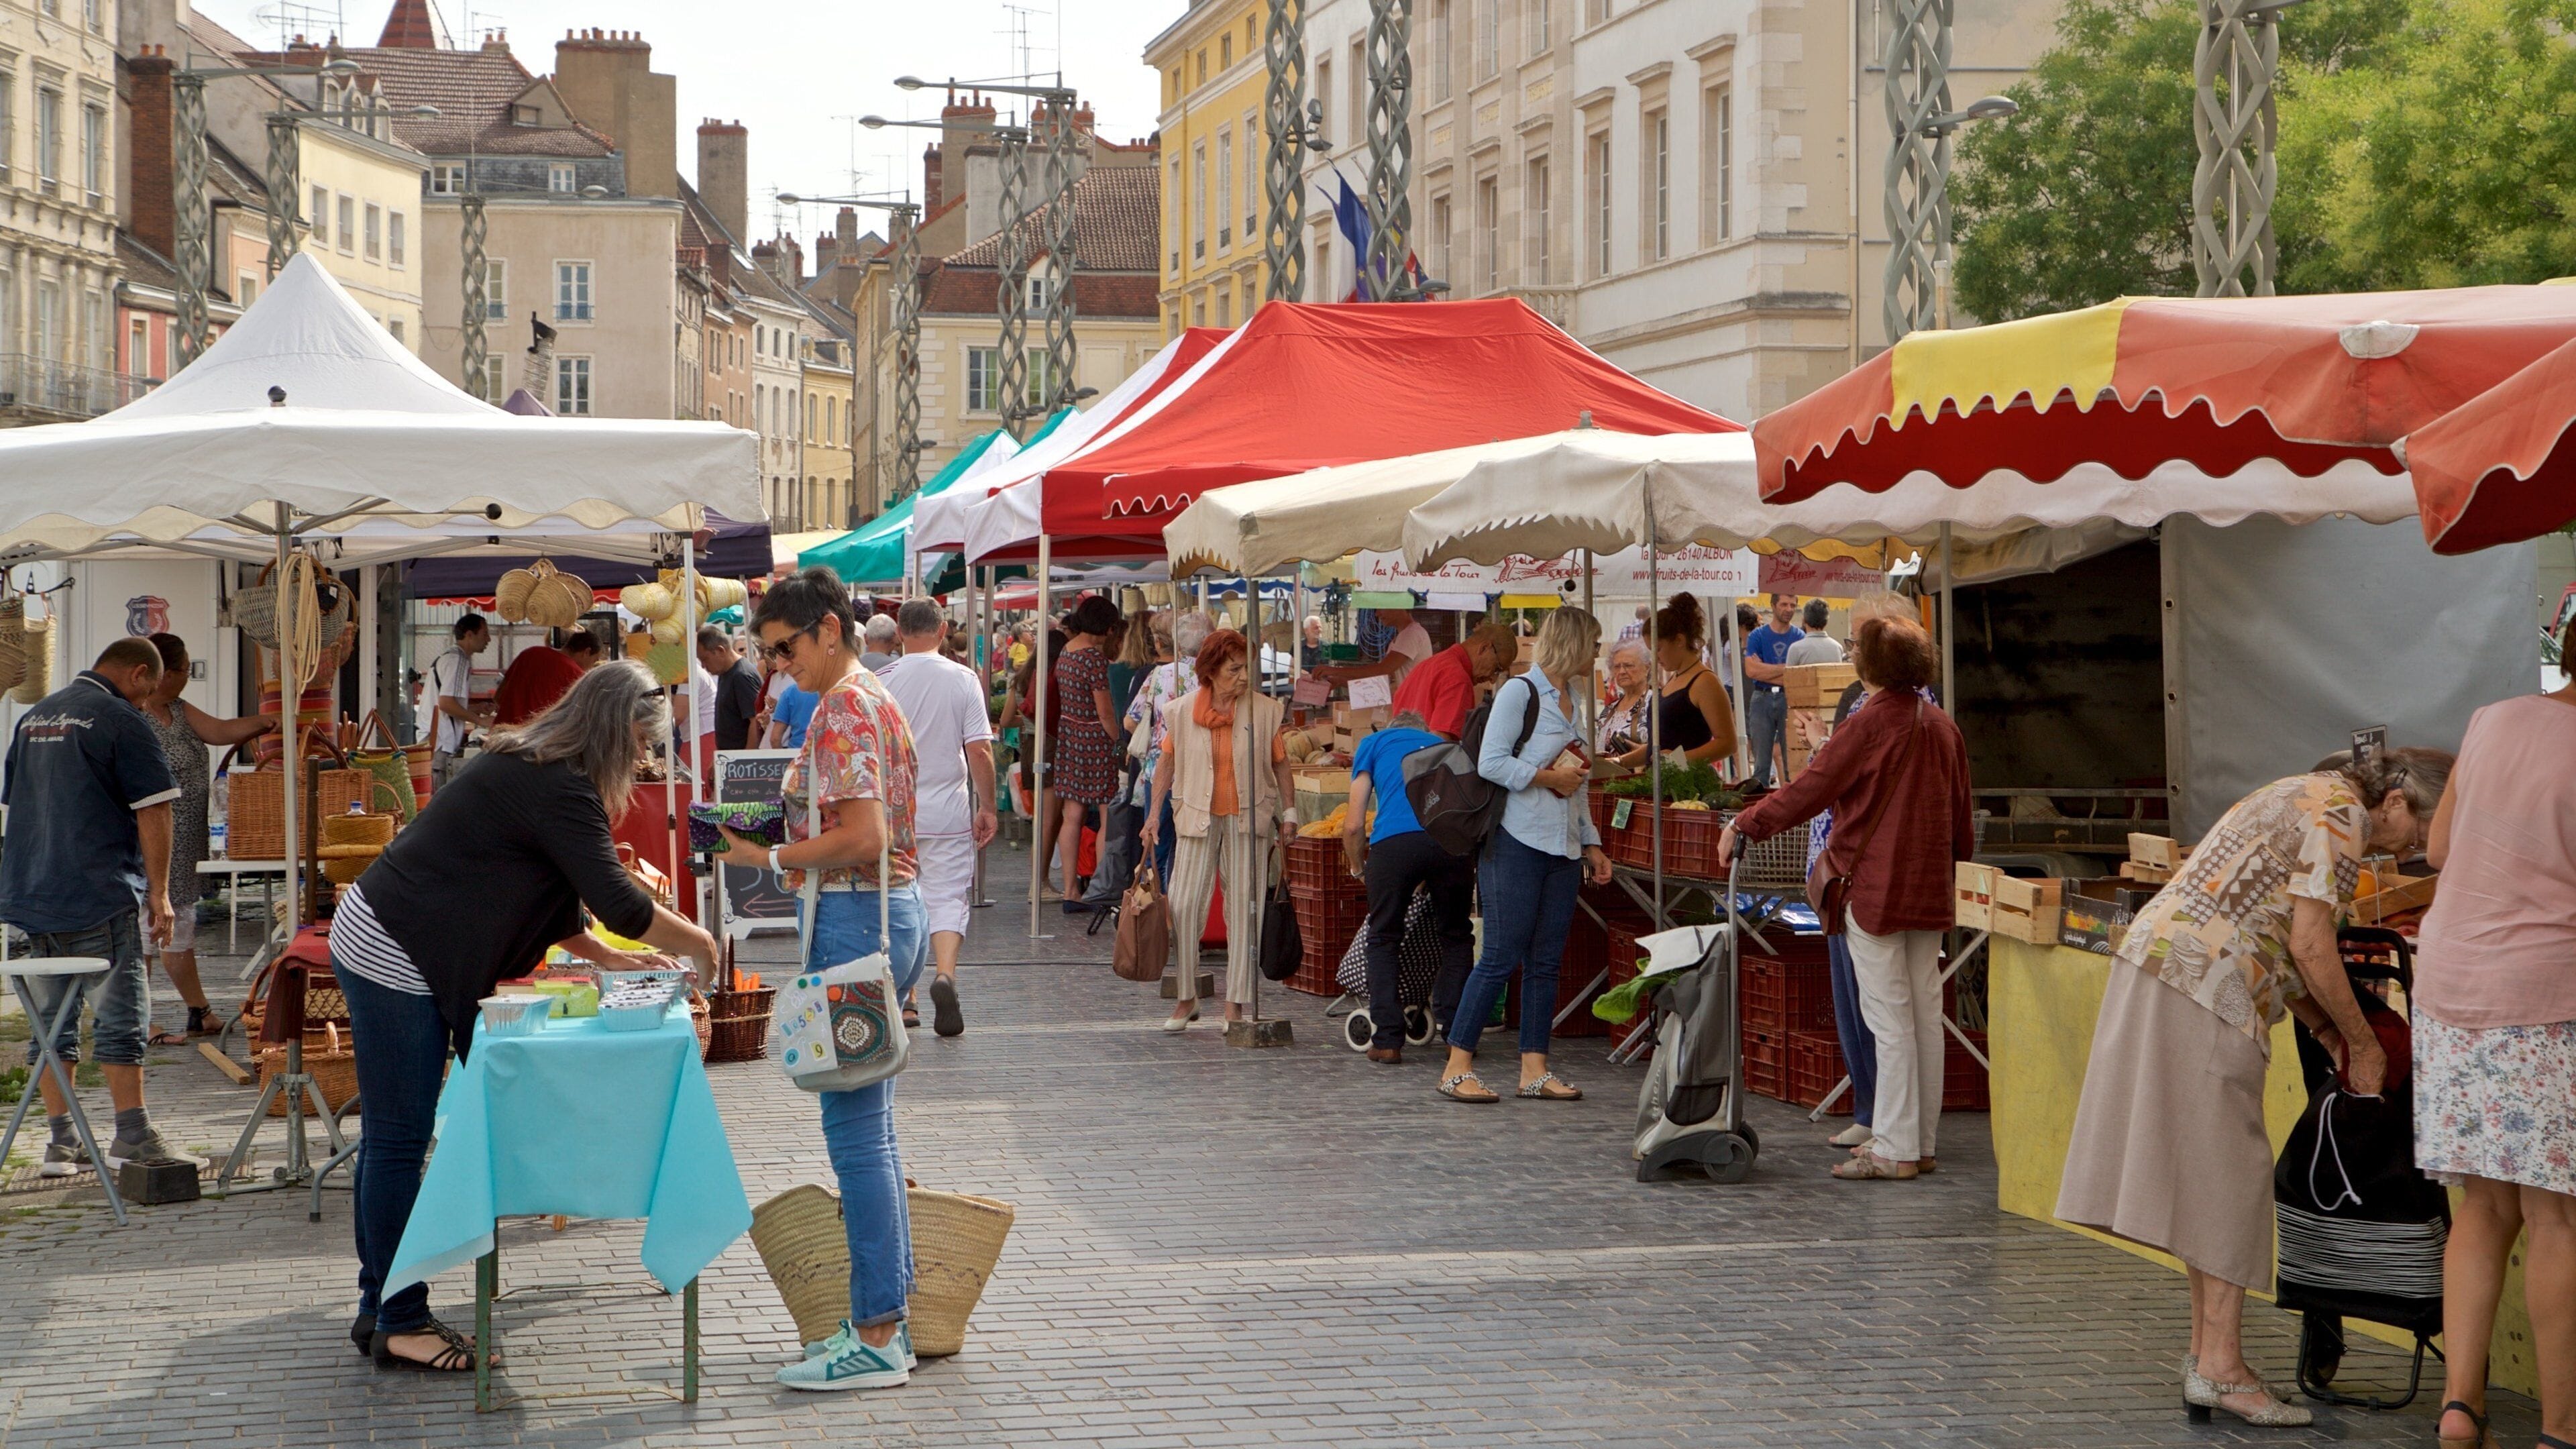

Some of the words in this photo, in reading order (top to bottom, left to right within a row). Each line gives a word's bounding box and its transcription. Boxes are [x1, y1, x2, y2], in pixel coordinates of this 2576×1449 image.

[1677, 547, 1702, 561] 26140
[1703, 547, 1733, 560] ALBON
[1373, 559, 1387, 576] les
[1451, 564, 1480, 578] Tour
